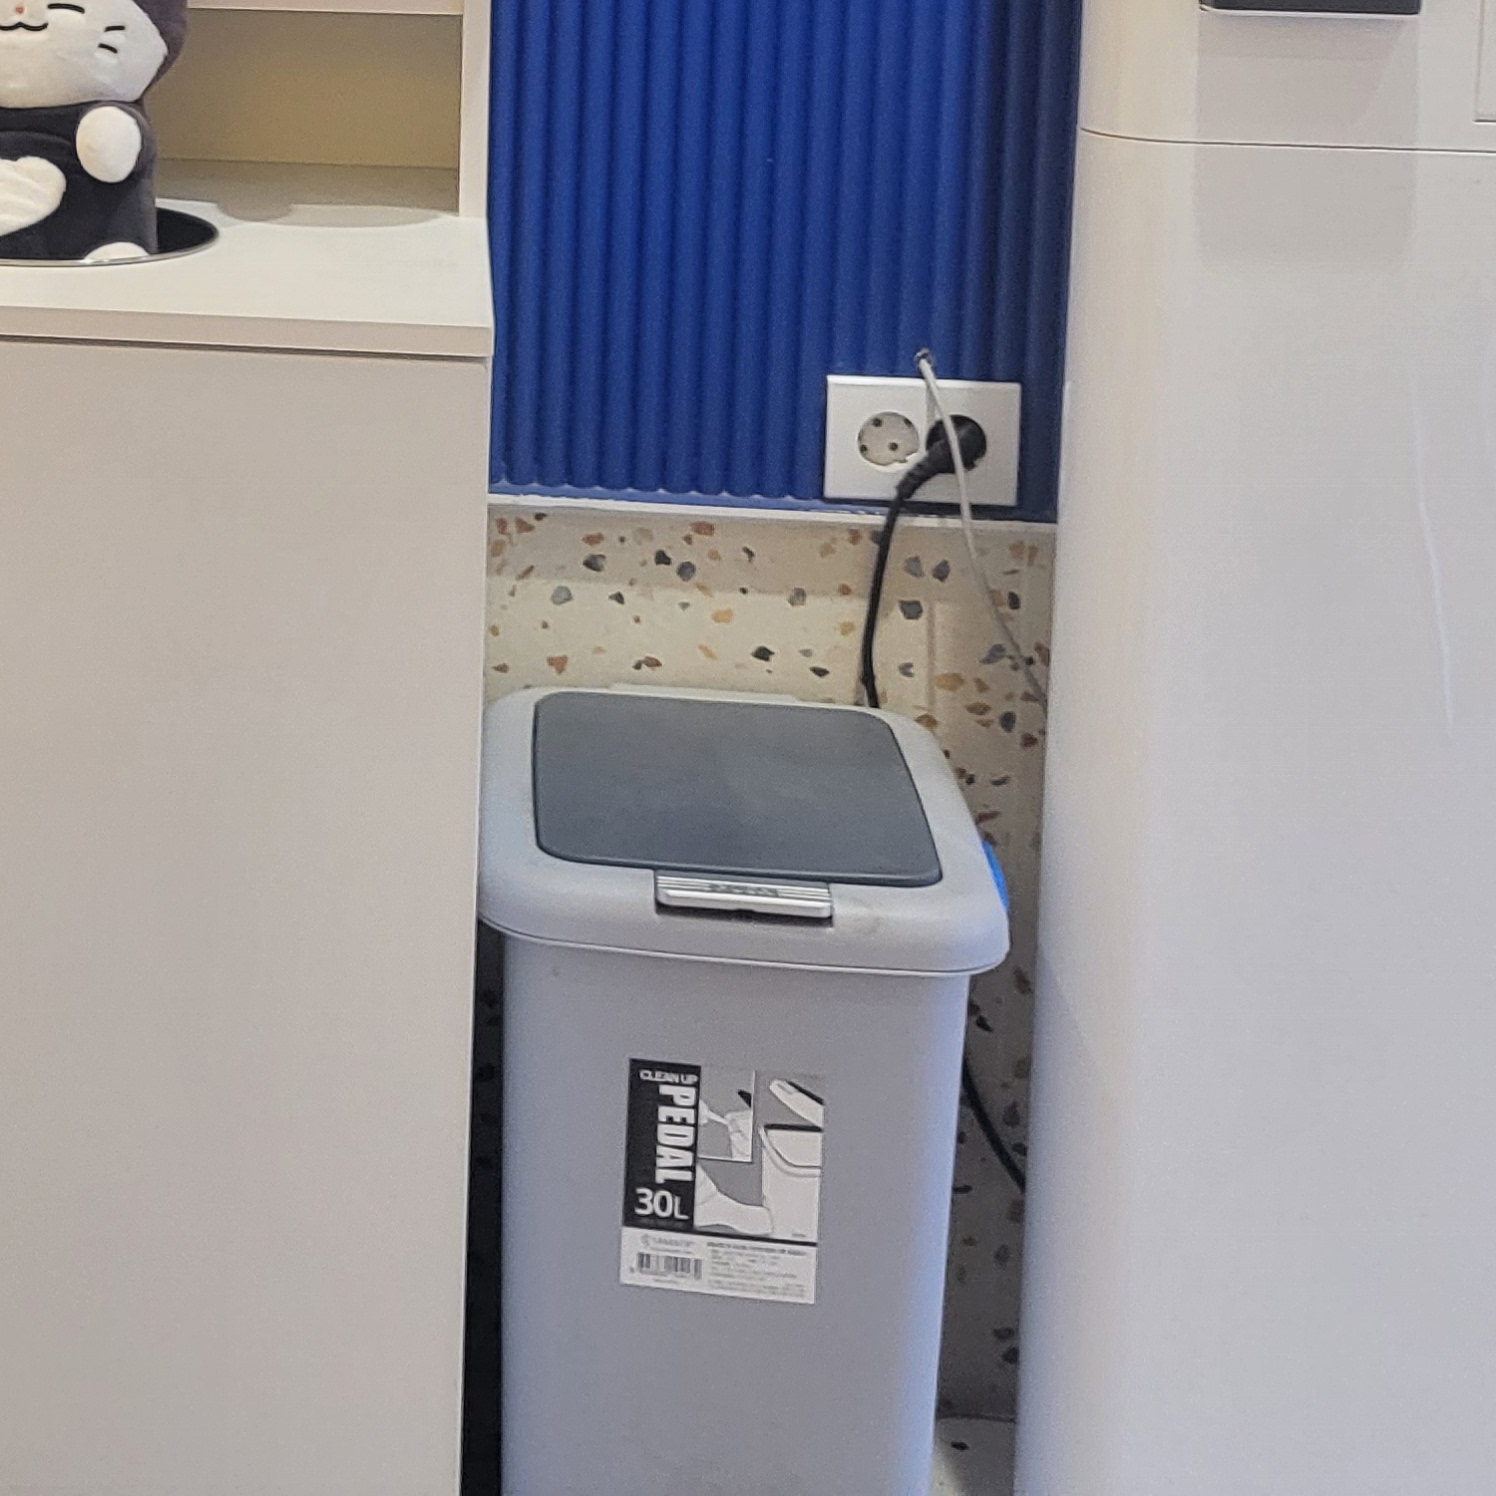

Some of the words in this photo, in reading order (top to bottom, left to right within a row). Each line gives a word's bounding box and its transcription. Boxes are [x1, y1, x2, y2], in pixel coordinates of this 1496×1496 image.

[639, 1069, 679, 1083] CLEAN
[680, 1073, 698, 1084] UP
[655, 1084, 696, 1184] PEDAL
[634, 1187, 690, 1220] 30L
